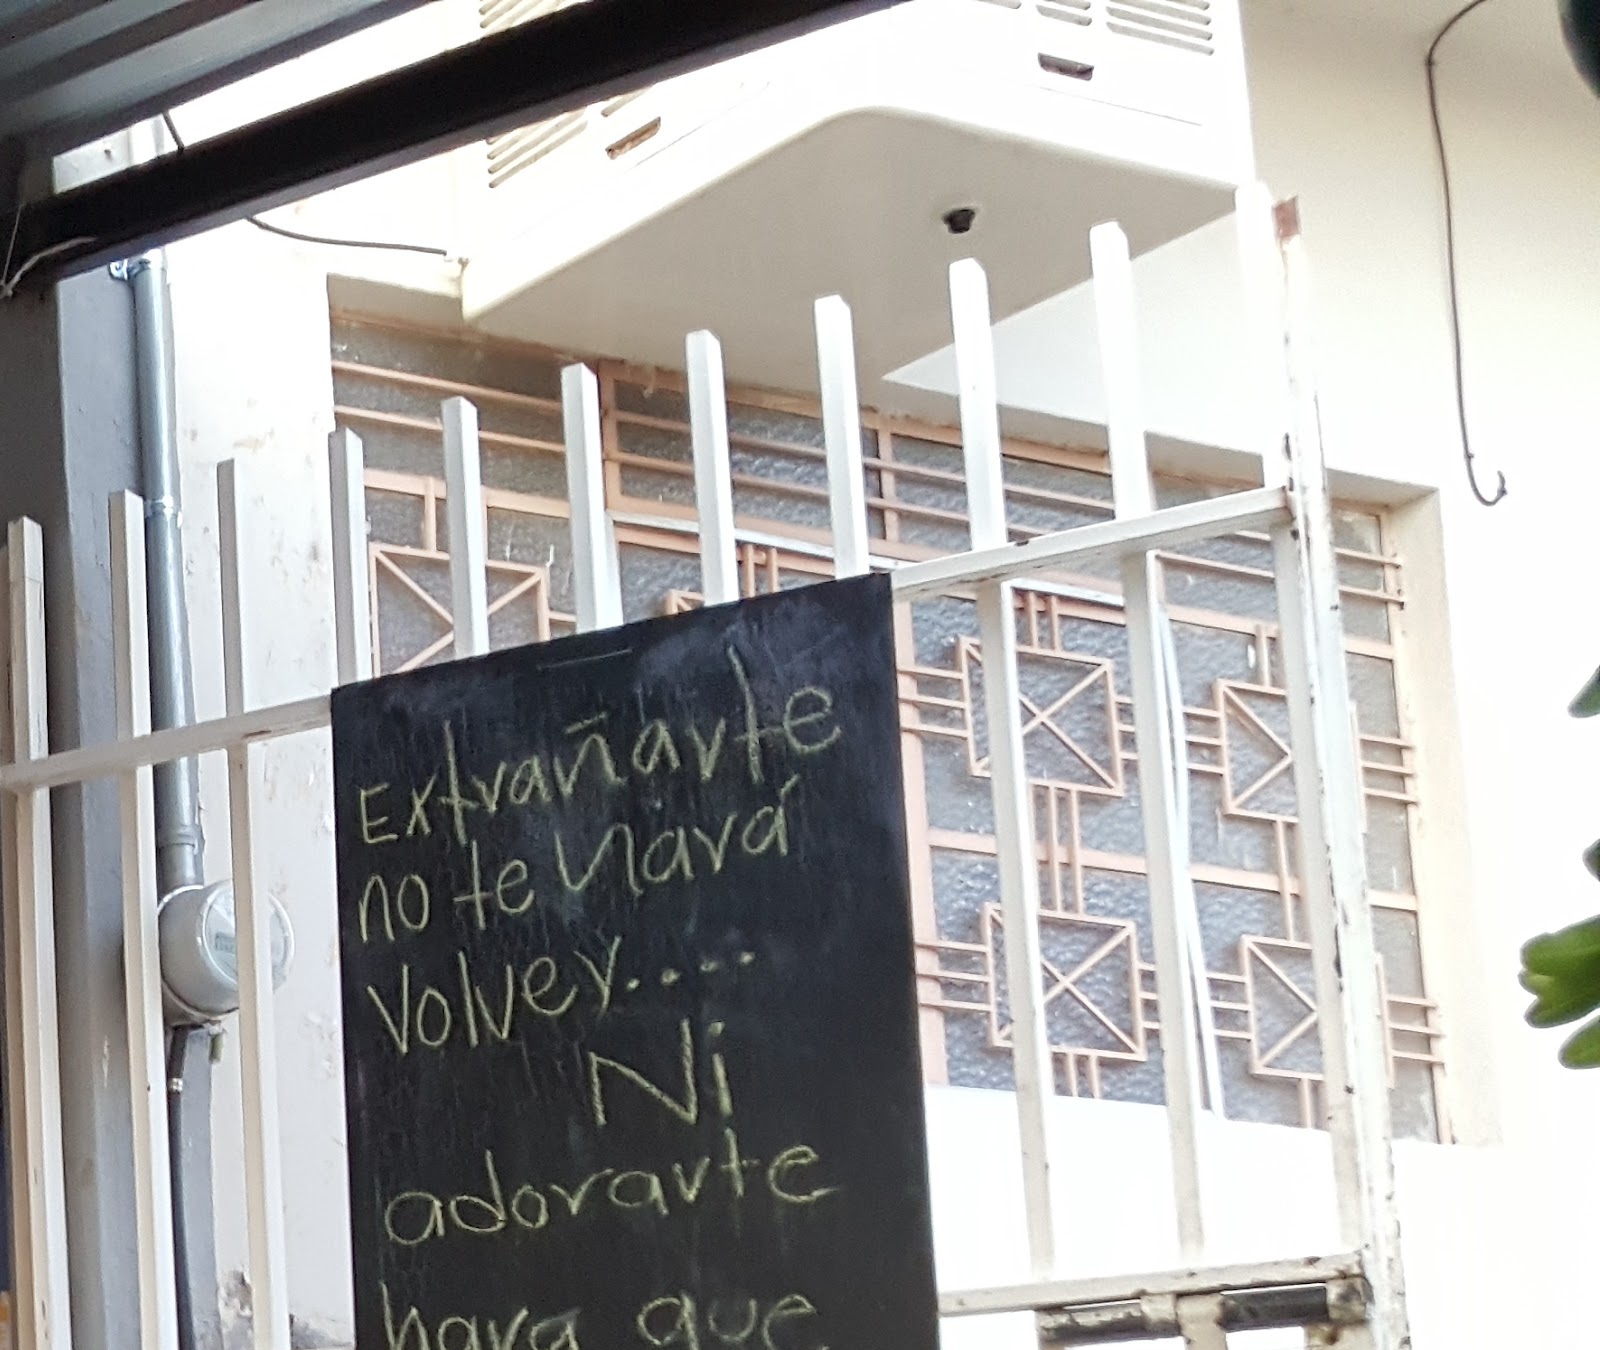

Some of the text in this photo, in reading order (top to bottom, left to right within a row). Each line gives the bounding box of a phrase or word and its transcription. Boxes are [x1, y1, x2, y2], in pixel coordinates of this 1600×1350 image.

[358, 873, 430, 943] no
[453, 839, 536, 931] te
[588, 1018, 733, 1126] Ni
[385, 1127, 841, 1245] adorarte
